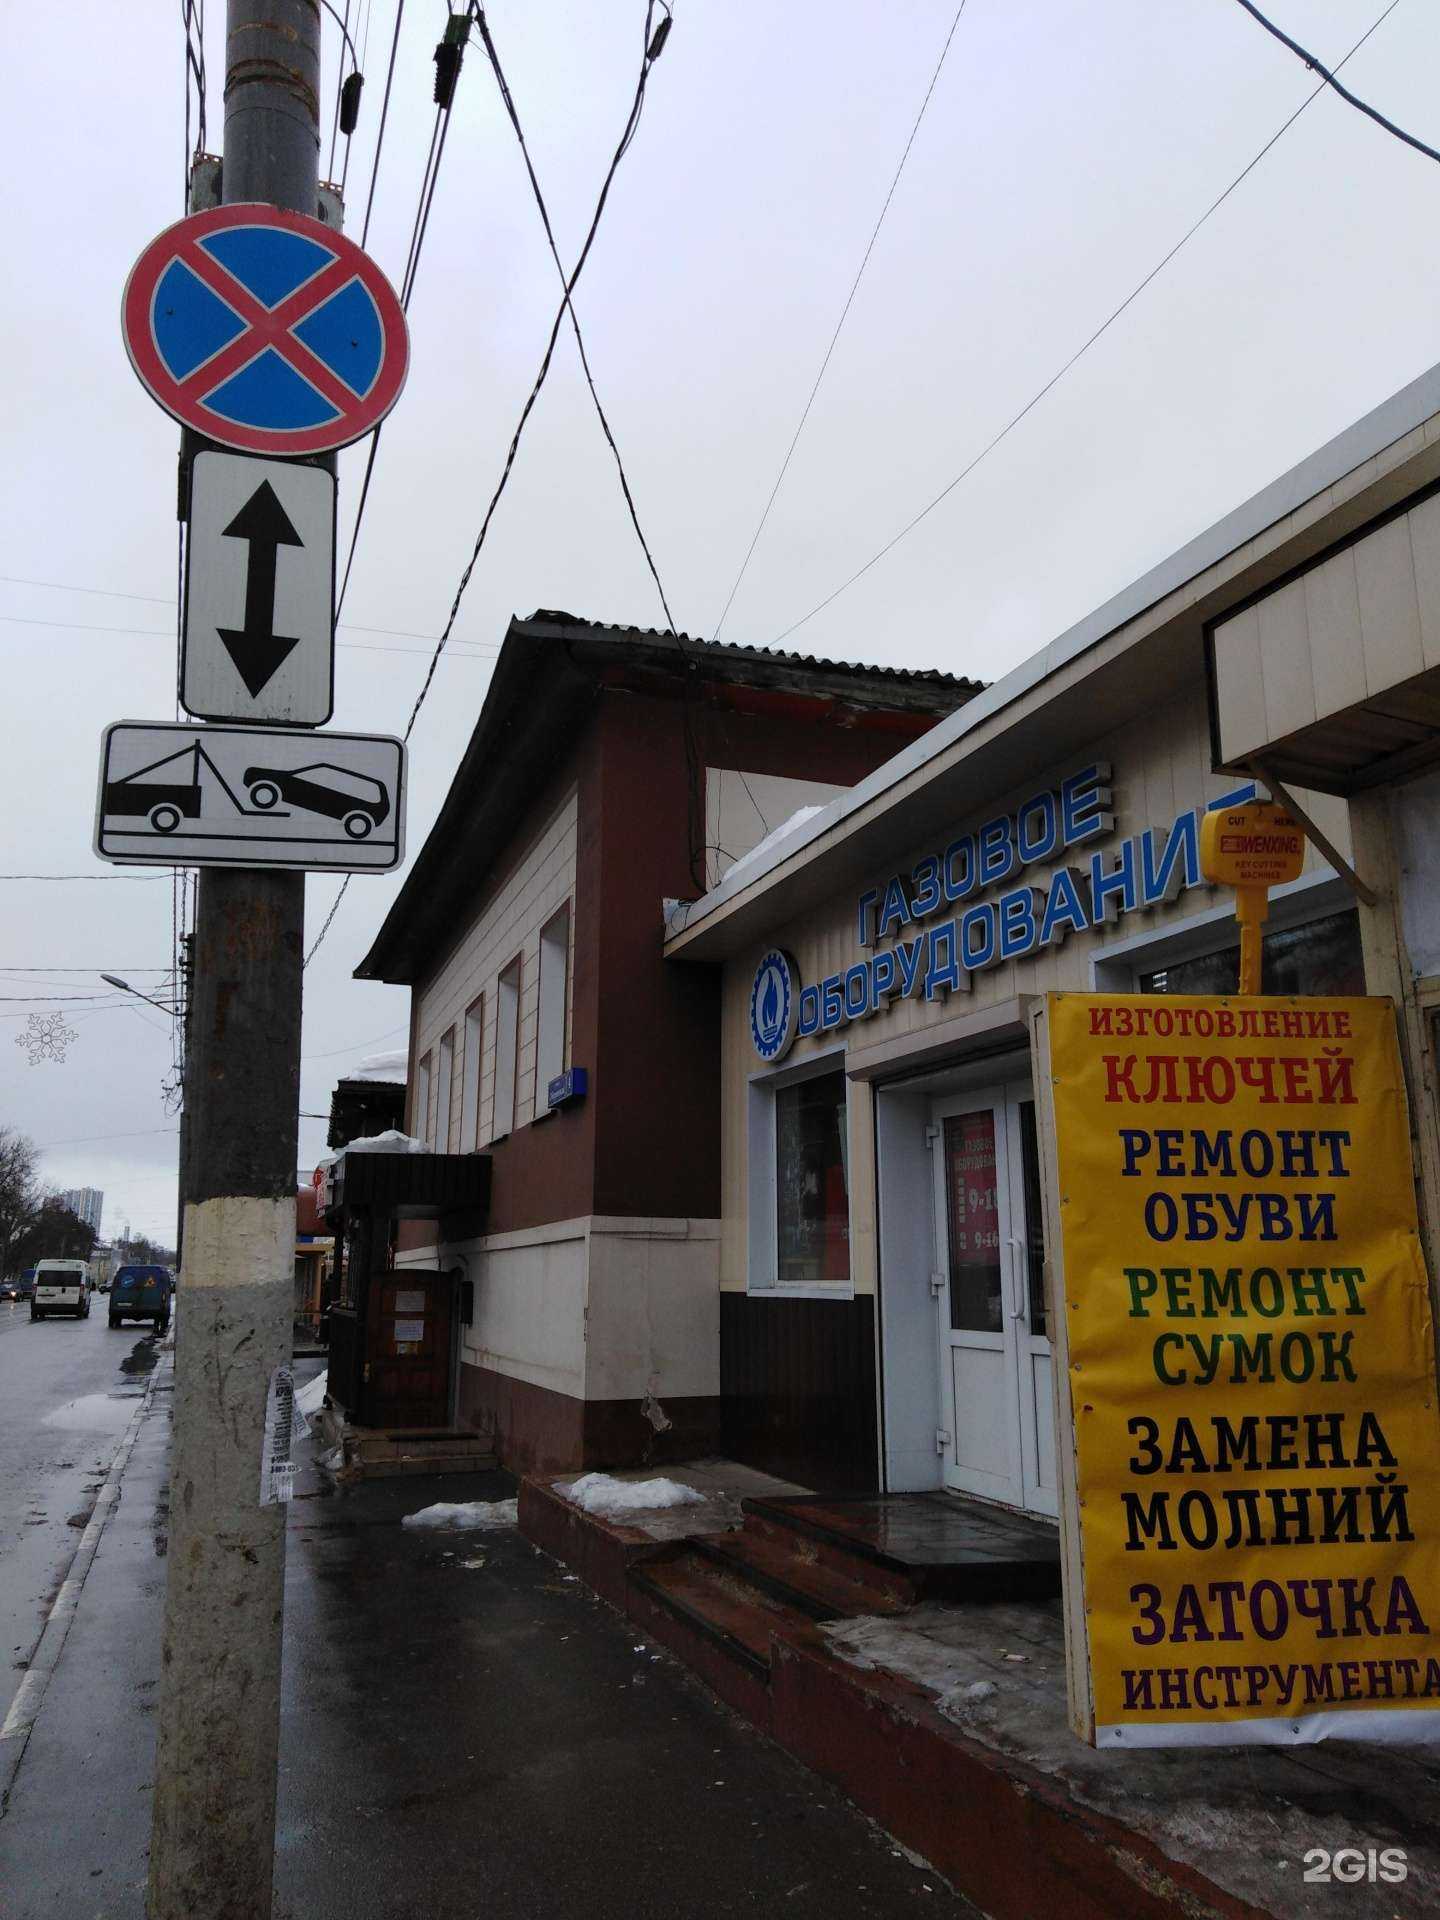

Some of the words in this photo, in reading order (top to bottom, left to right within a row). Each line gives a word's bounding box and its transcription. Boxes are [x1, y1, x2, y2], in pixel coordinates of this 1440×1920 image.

[1228, 816, 1245, 826] CUT
[858, 764, 1100, 947] ГАЗОВОЕ
[1089, 1007, 1353, 1039] ИЗГОТОВЛЕНИЕ
[1102, 1047, 1359, 1104] КЛЮЧЕЙ
[1119, 1129, 1351, 1178] РЕМОНТ
[1144, 1192, 1338, 1242] ОБУВИ
[1123, 1267, 1367, 1318] РЕМОНТ
[1153, 1330, 1358, 1386] СУМОК
[1127, 1411, 1398, 1475] ЗАМЕНА
[1120, 1472, 1415, 1551] МОЛНИЙ
[1129, 1575, 1430, 1646] ЗАТОЧКА
[1121, 1658, 1440, 1711] ИНСТРУМЕНТА
